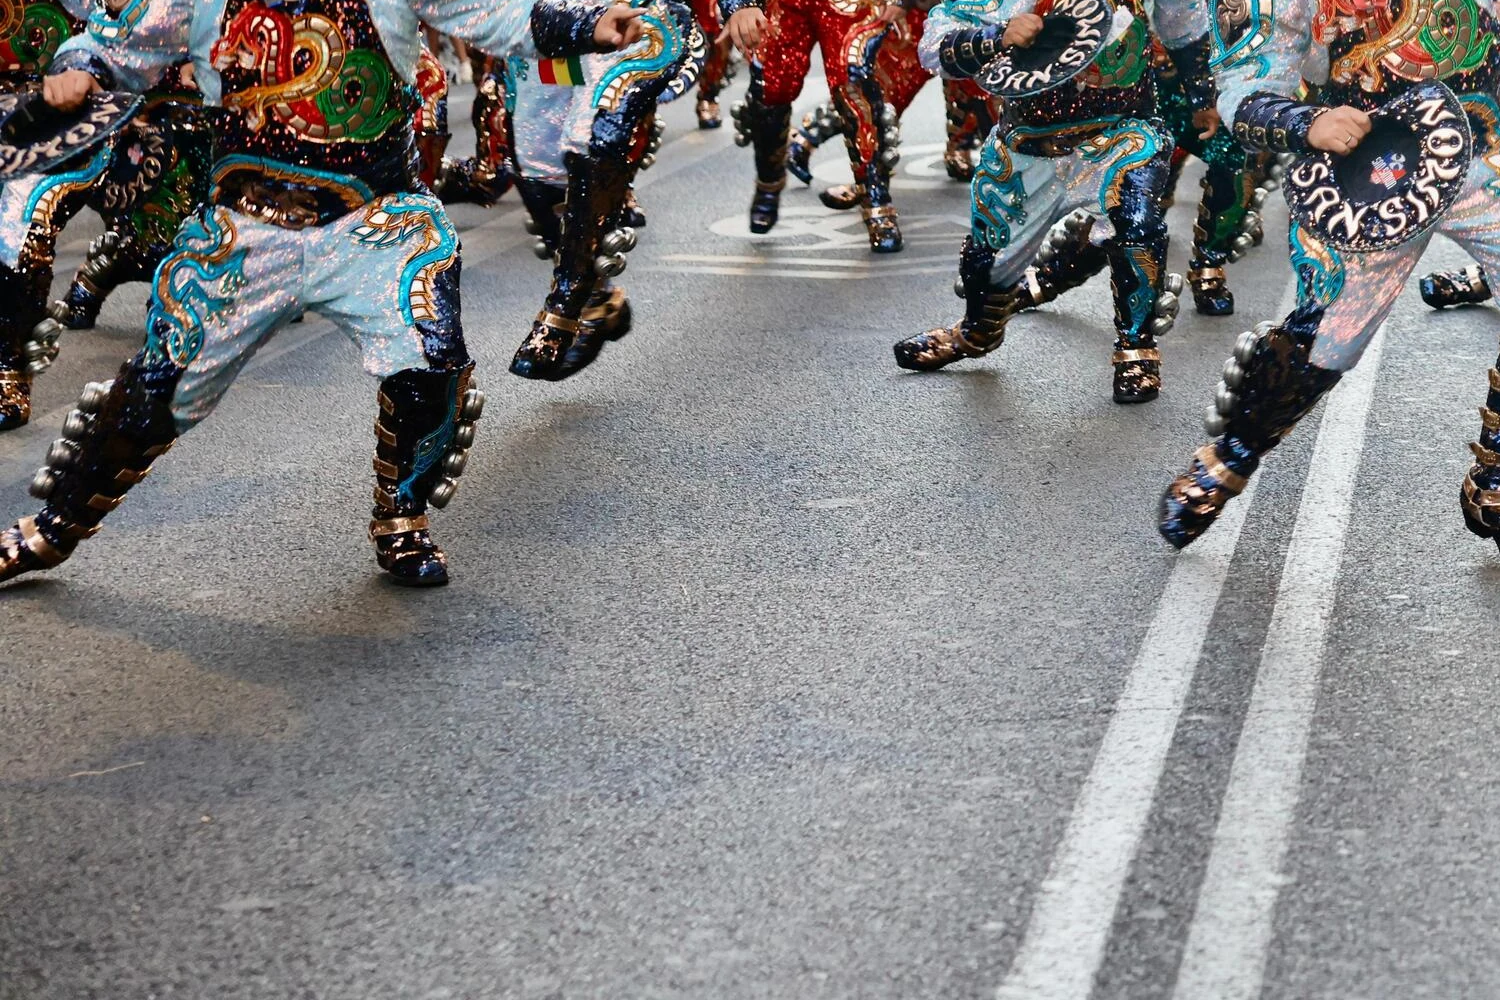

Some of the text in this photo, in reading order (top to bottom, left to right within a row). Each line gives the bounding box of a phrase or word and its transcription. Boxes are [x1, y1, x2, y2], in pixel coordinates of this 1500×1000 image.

[985, 62, 1053, 90] SAN
[1291, 99, 1463, 239] SAN SIMON
